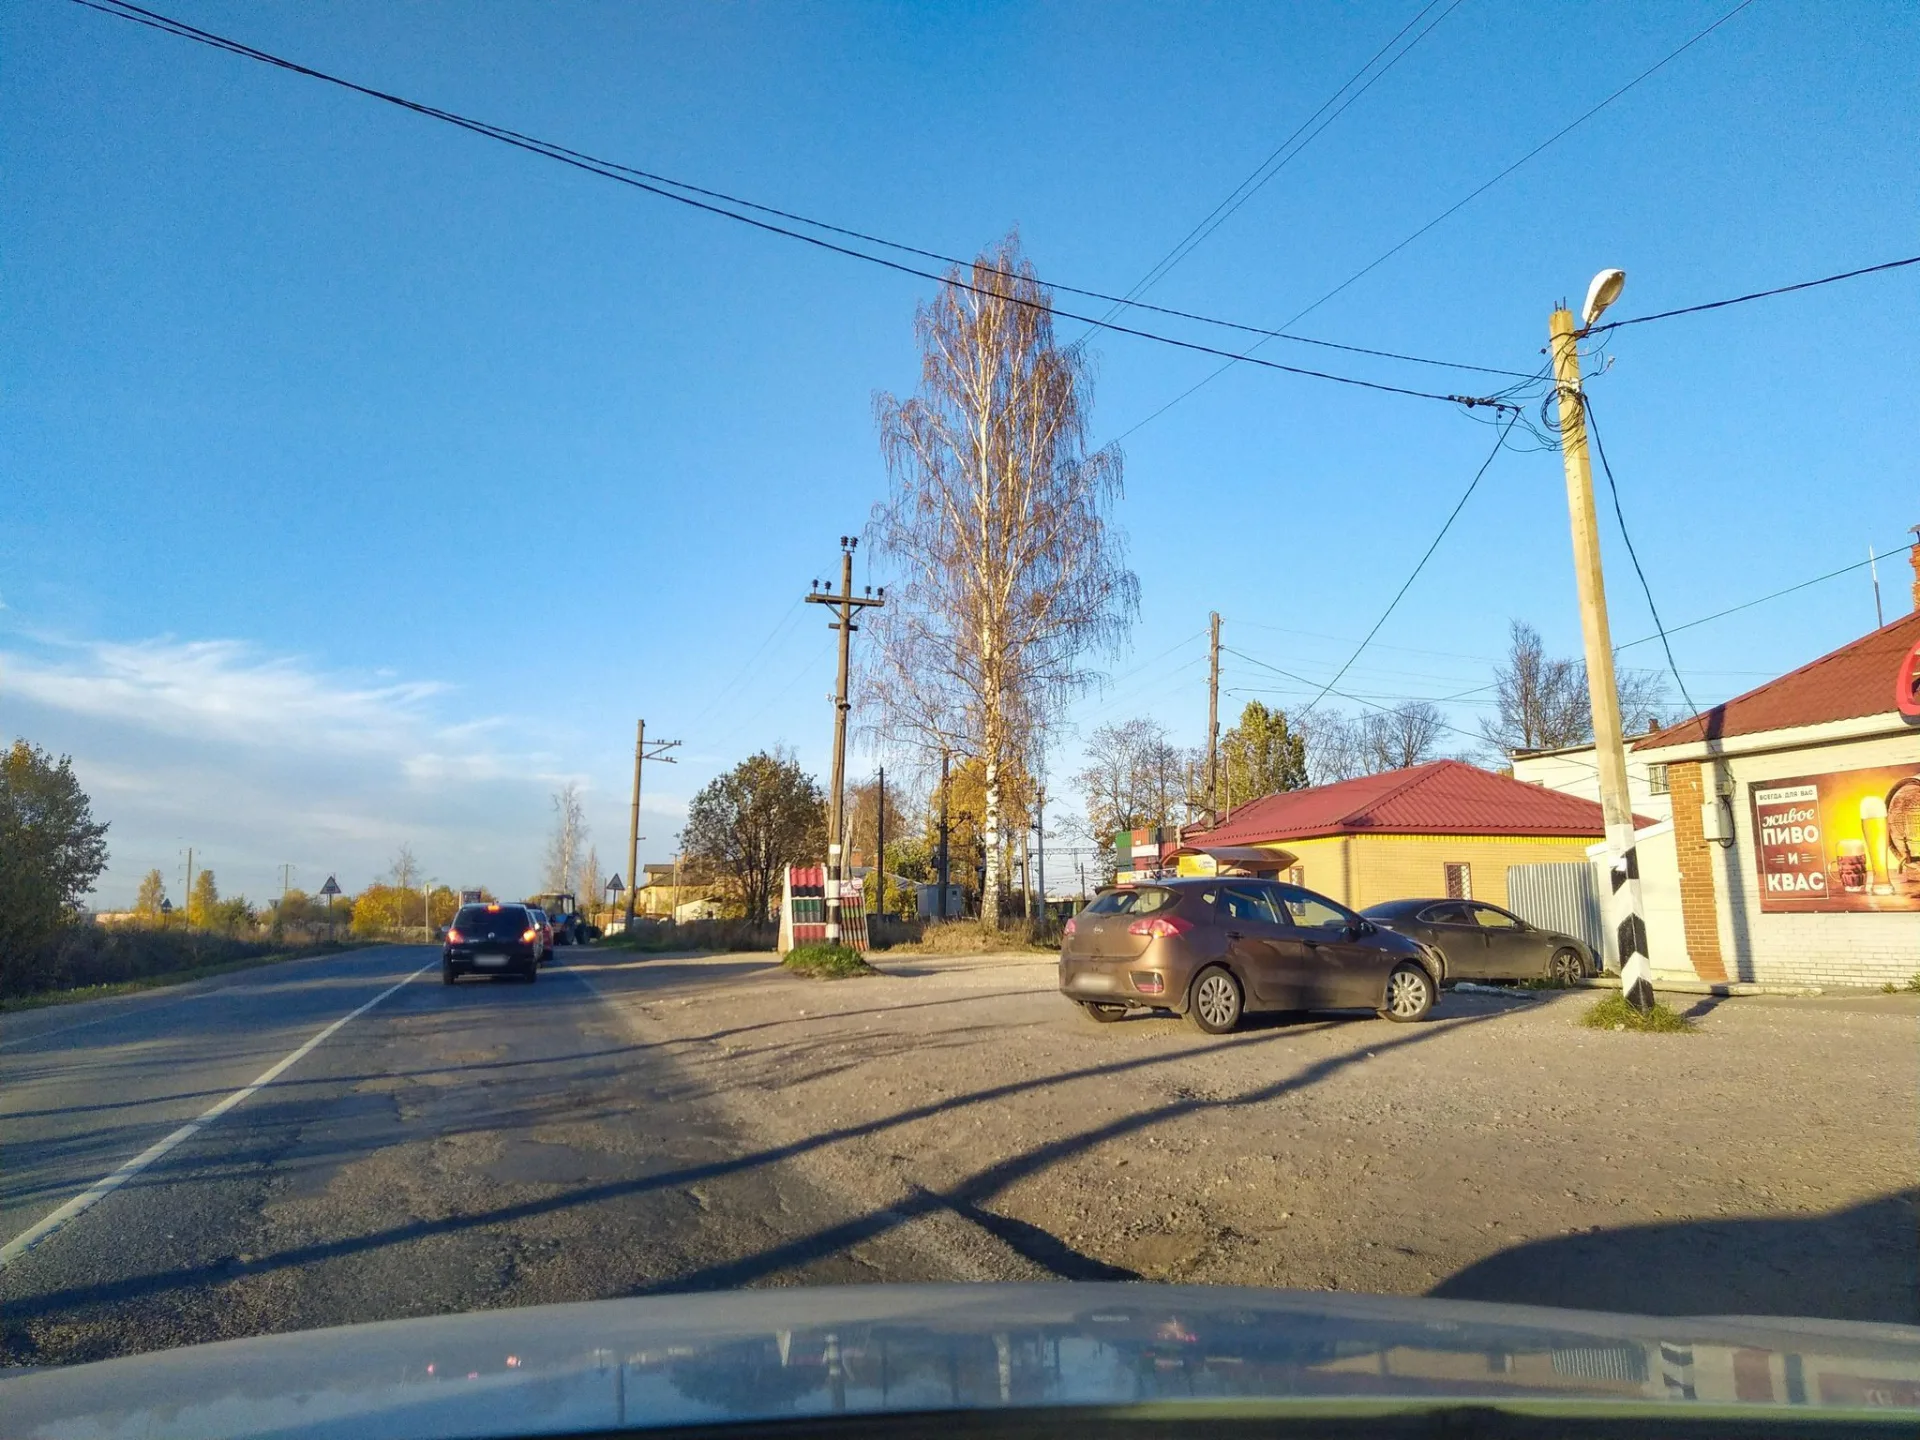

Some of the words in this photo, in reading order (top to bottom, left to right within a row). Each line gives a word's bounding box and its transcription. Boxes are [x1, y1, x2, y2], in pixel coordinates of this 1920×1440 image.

[1759, 793, 1782, 801] ВСЕГДА
[1784, 791, 1798, 799] ДЛЯ
[1800, 789, 1813, 797] ВАС
[1762, 807, 1815, 828] живое
[1762, 824, 1819, 846] ПИВО
[1787, 852, 1799, 865] И
[1767, 871, 1825, 892] КВАС
